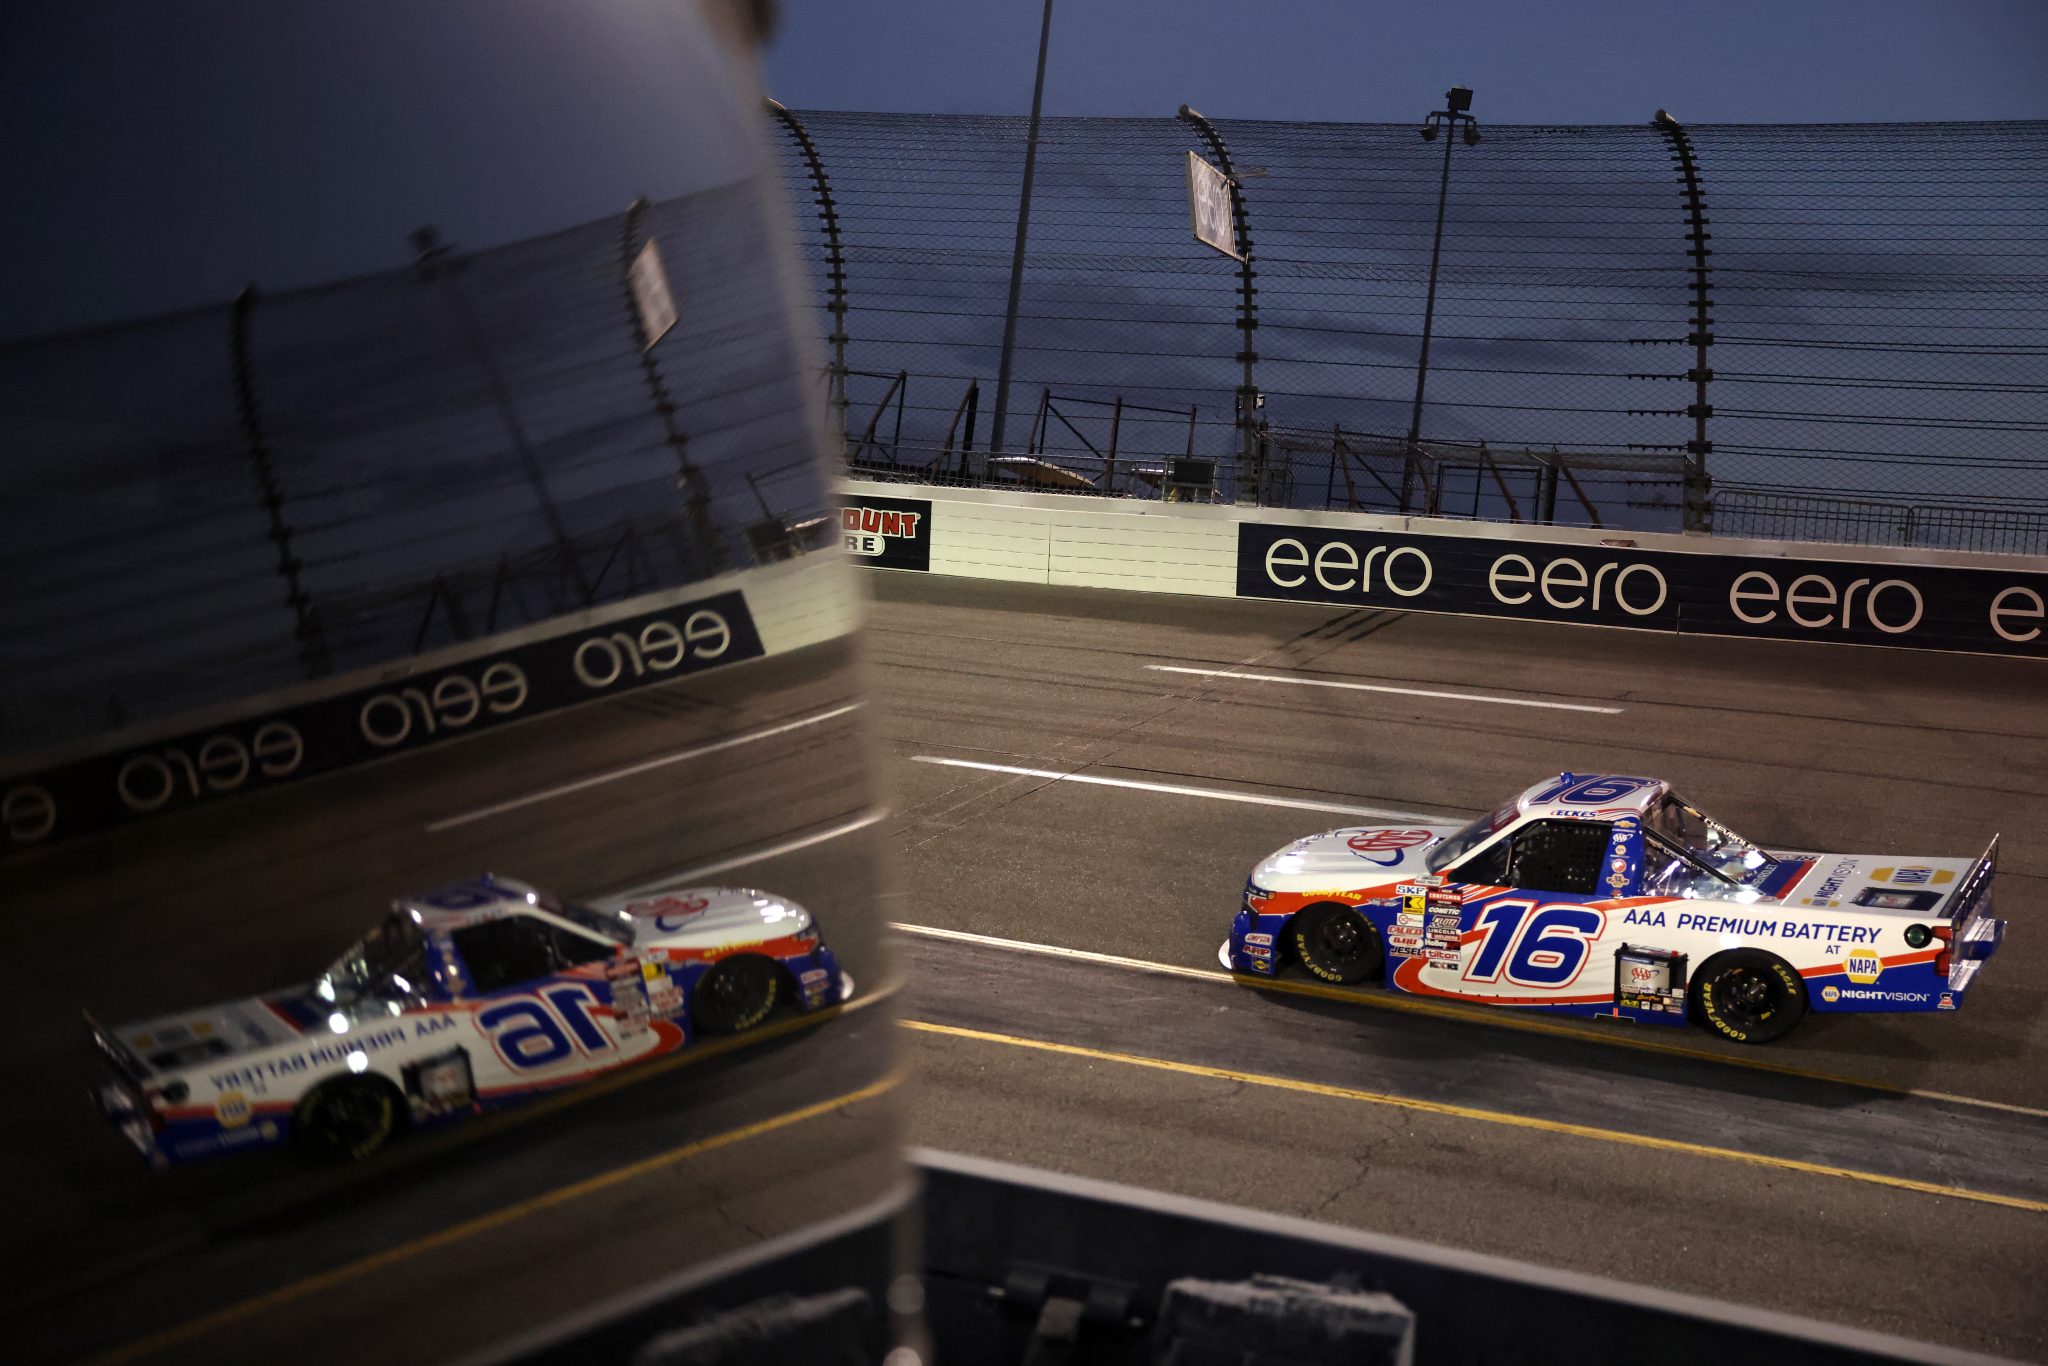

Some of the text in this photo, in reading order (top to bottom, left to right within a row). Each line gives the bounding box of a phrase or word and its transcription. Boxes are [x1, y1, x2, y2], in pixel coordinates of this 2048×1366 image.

[842, 507, 918, 538] OUNT
[844, 536, 875, 551] RE
[1265, 538, 1433, 597] eero
[1489, 553, 1668, 616] eero
[1729, 571, 1924, 633] eero
[1528, 774, 1661, 805] 16
[1302, 888, 1362, 901] GOODYEAR
[1397, 886, 1424, 894] SKF
[1623, 909, 1883, 944] AAA PREMIUM BATTERY
[1244, 945, 1271, 957] ARP
[1390, 946, 1422, 955] JESEL
[1464, 899, 1605, 989] 16
[1825, 945, 1841, 955] AT
[1428, 950, 1459, 960] tilton
[1849, 959, 1877, 974] NAPA
[1703, 982, 1747, 1040] GOODYEAR
